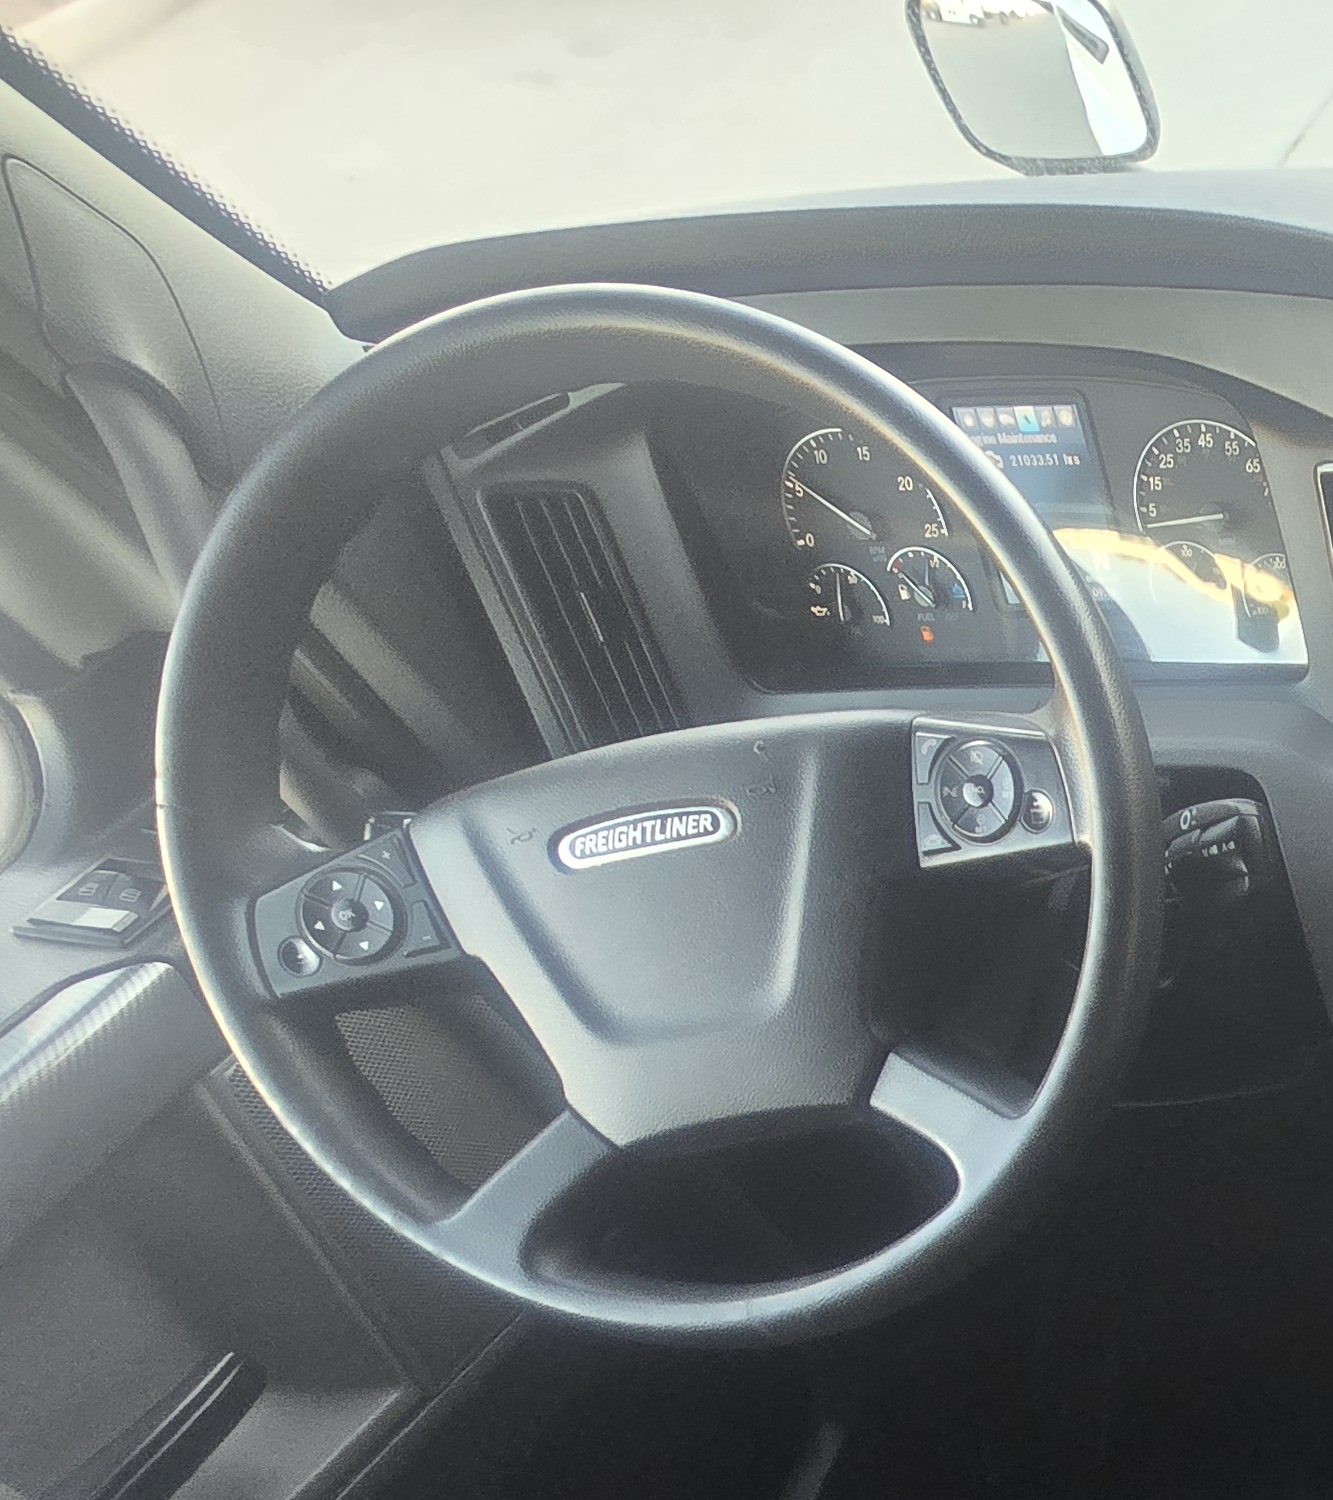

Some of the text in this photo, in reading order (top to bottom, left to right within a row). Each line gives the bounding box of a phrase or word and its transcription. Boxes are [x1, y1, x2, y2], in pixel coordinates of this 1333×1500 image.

[997, 432, 1057, 445] Maintenance
[1175, 438, 1191, 453] 35
[1198, 433, 1213, 447] 45
[857, 446, 870, 461] 15
[1225, 441, 1239, 456] 55
[814, 450, 827, 464] 10
[1009, 454, 1059, 467] 21033.51
[1159, 454, 1174, 468] 25
[1245, 458, 1260, 473] 65
[897, 476, 913, 491] 20
[1149, 476, 1162, 490] 15
[795, 484, 804, 497] 5
[1149, 503, 1157, 517] 5
[924, 524, 939, 538] 25
[806, 533, 814, 547] 0
[574, 813, 714, 858] FREIGHTLINER
[338, 908, 356, 921] OK
